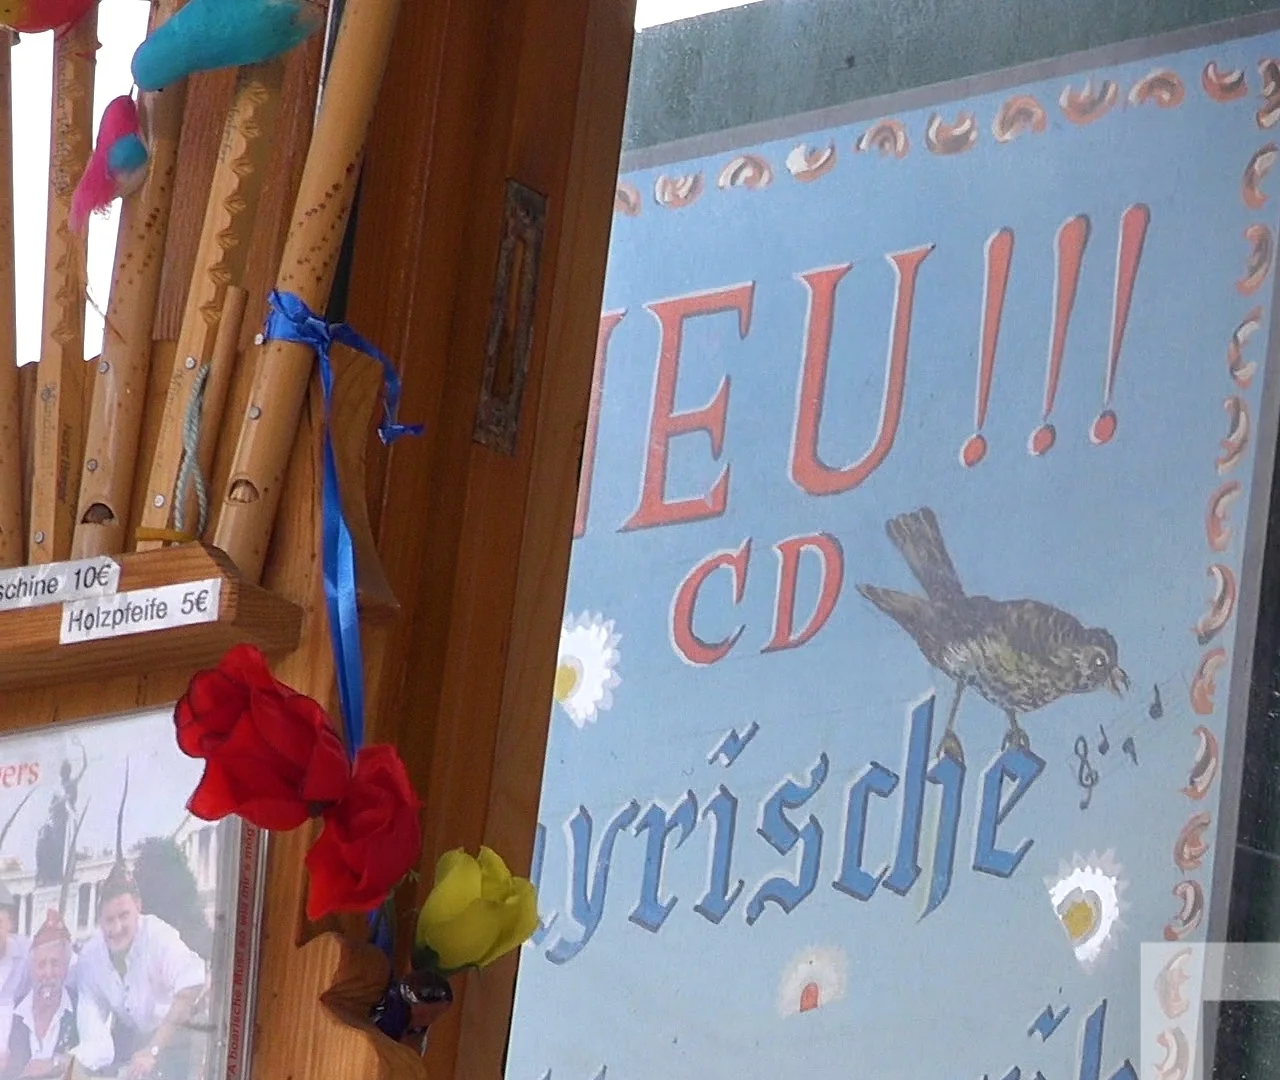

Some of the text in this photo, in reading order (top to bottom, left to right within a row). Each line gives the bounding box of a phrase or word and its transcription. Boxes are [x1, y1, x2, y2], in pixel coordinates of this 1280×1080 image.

[573, 202, 1151, 538] EU!!!
[74, 563, 112, 591] 10€
[669, 530, 846, 667] CD
[68, 588, 209, 633] Holzpfeife 5€
[0, 761, 39, 788] ers
